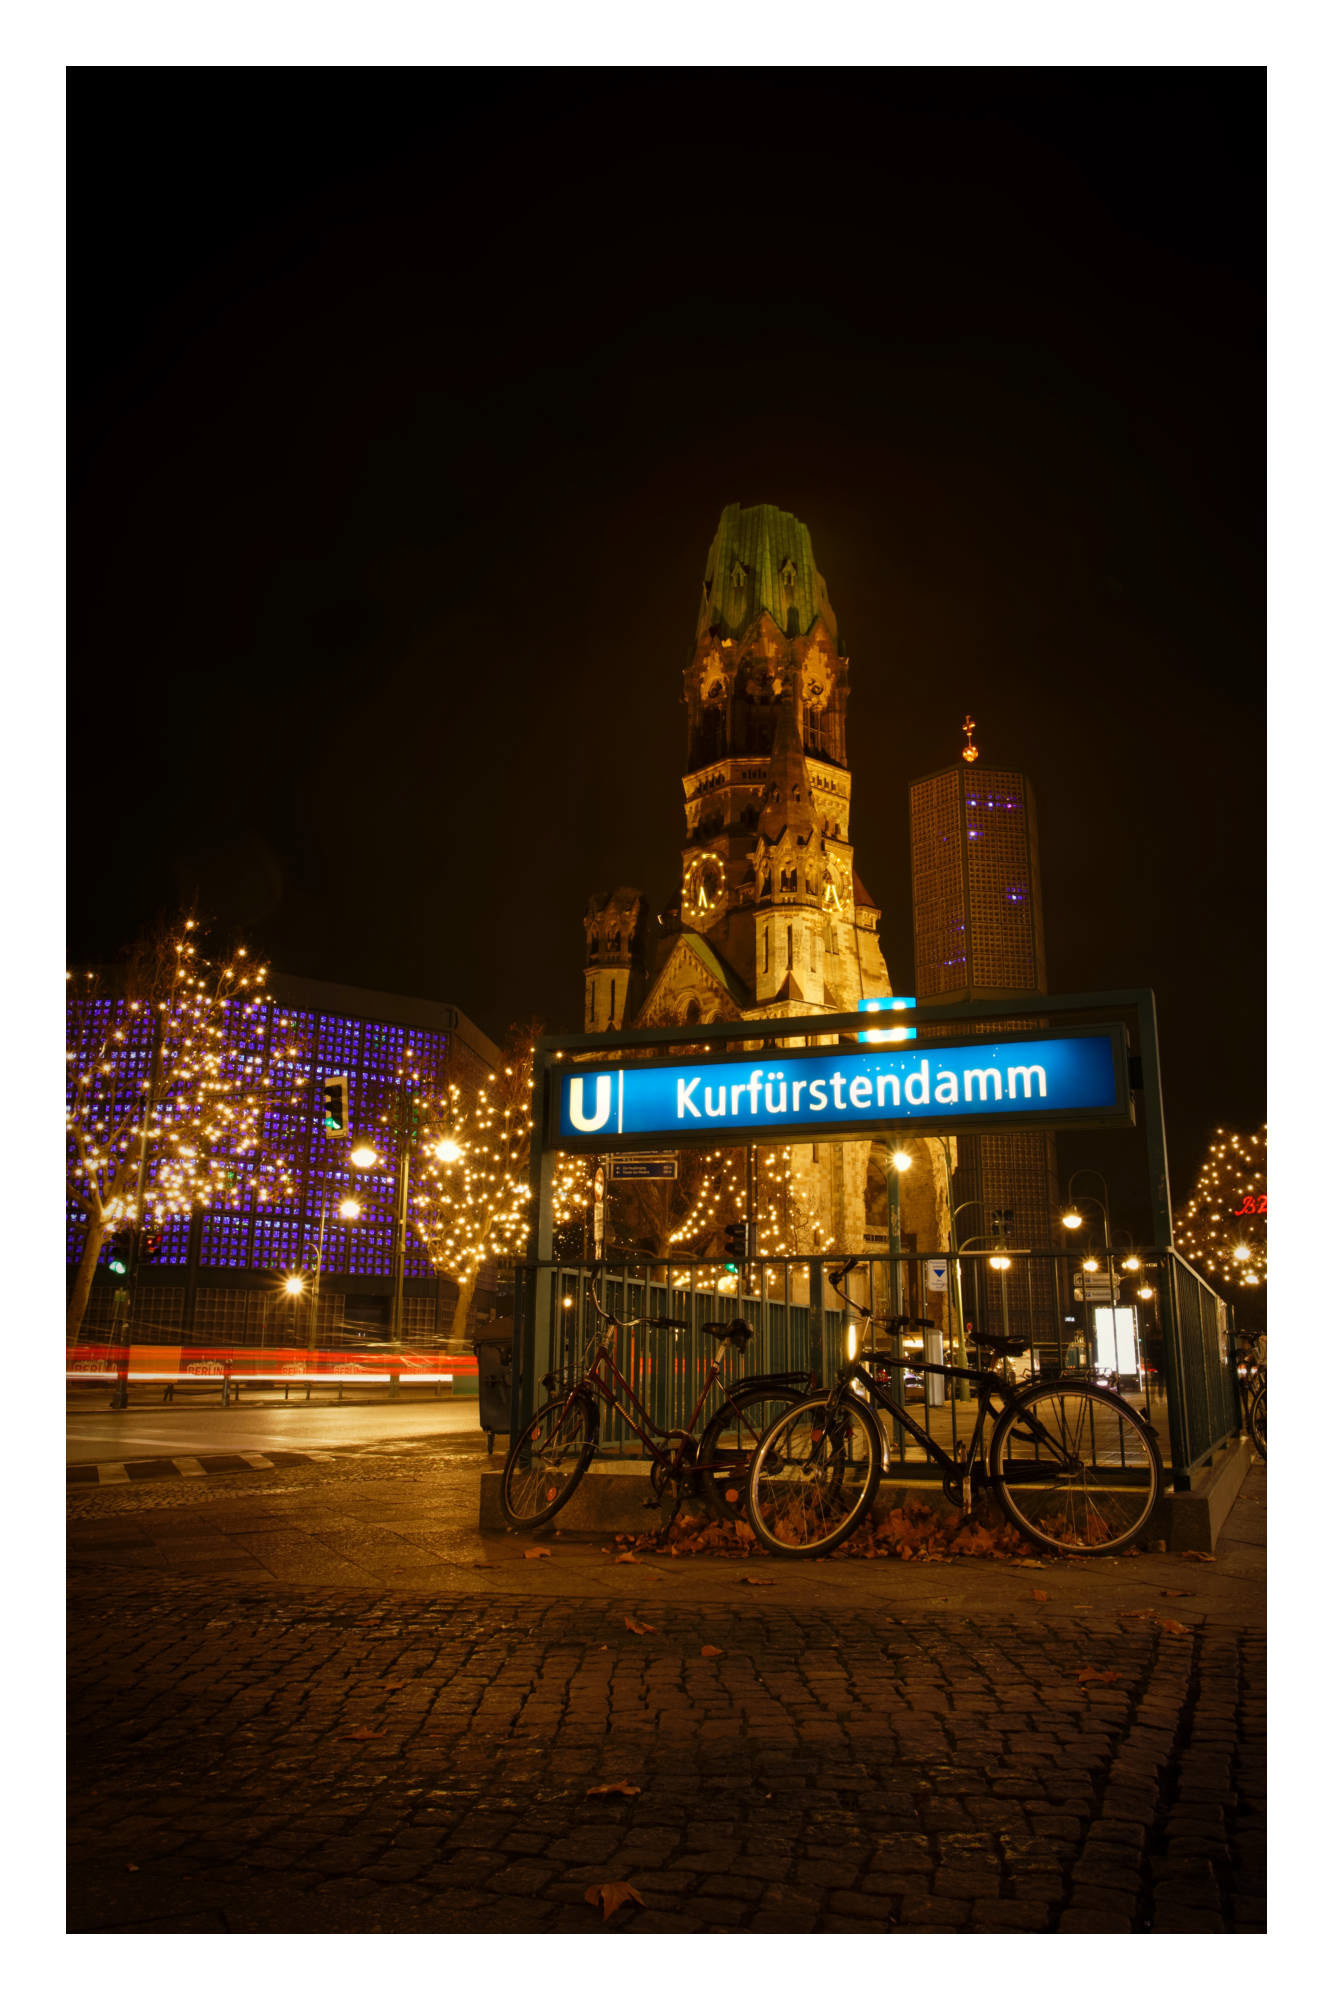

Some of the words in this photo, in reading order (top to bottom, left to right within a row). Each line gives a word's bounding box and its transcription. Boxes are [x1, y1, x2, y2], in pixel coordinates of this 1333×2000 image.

[568, 1075, 612, 1132] U
[675, 1060, 1048, 1119] Kurfürstendamm
[188, 1366, 224, 1376] BERLIN
